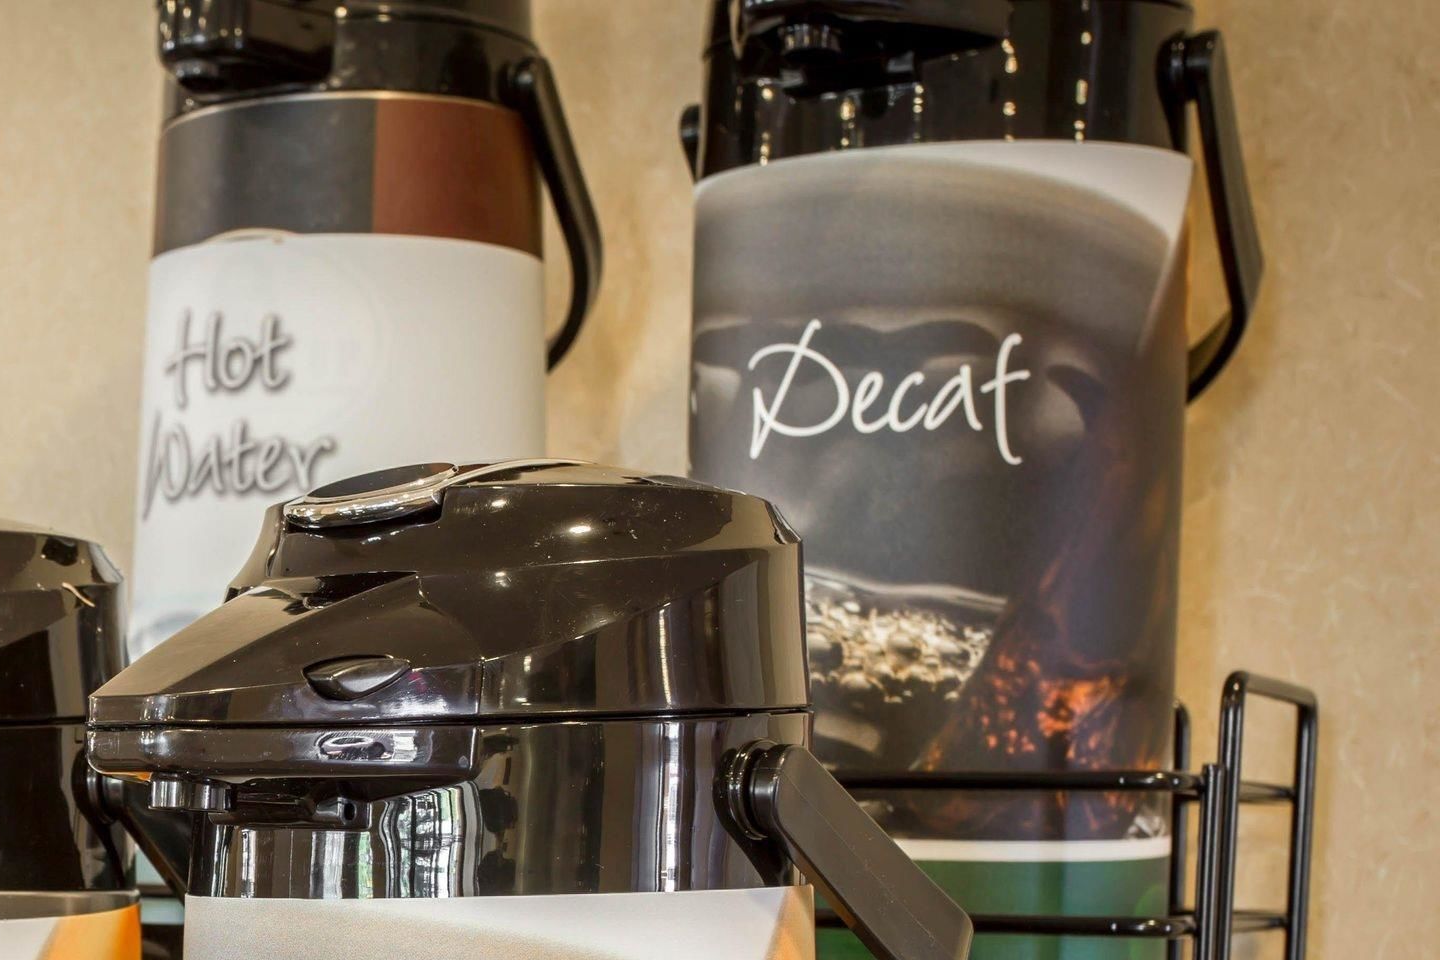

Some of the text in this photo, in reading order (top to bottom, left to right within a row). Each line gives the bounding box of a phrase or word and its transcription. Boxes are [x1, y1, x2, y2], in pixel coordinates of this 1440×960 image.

[164, 307, 295, 409] Hot
[748, 319, 1031, 466] Decaf
[142, 408, 339, 523] Water
